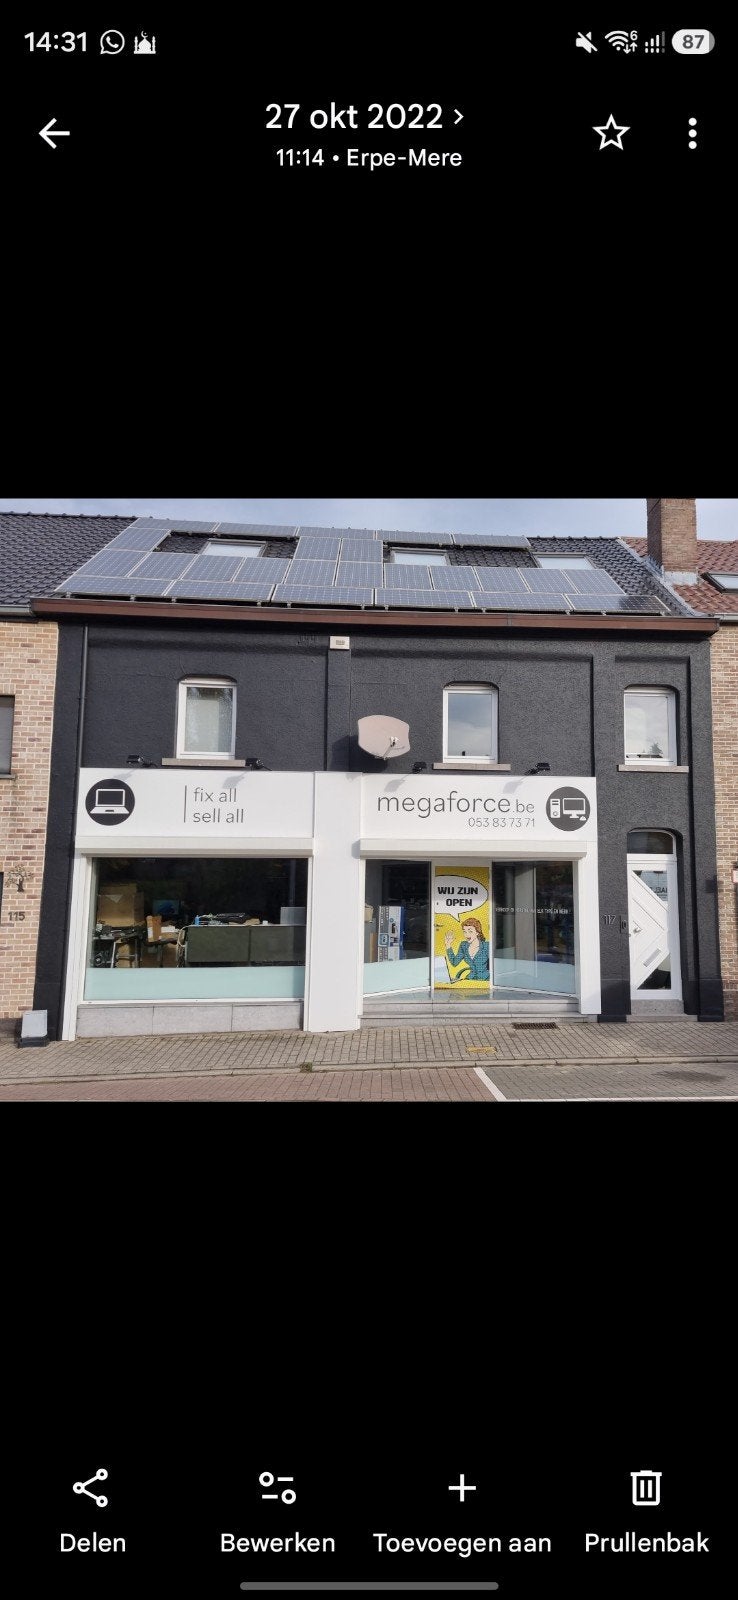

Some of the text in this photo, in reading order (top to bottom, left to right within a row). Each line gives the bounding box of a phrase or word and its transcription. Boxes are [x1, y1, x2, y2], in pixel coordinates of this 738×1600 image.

[193, 787, 238, 803] fix all
[192, 807, 245, 824] sell all
[468, 817, 536, 828] 053 83 73 71
[437, 886, 479, 895] WIJ ZIJN
[445, 898, 473, 907] OPEN
[8, 911, 26, 921] 115
